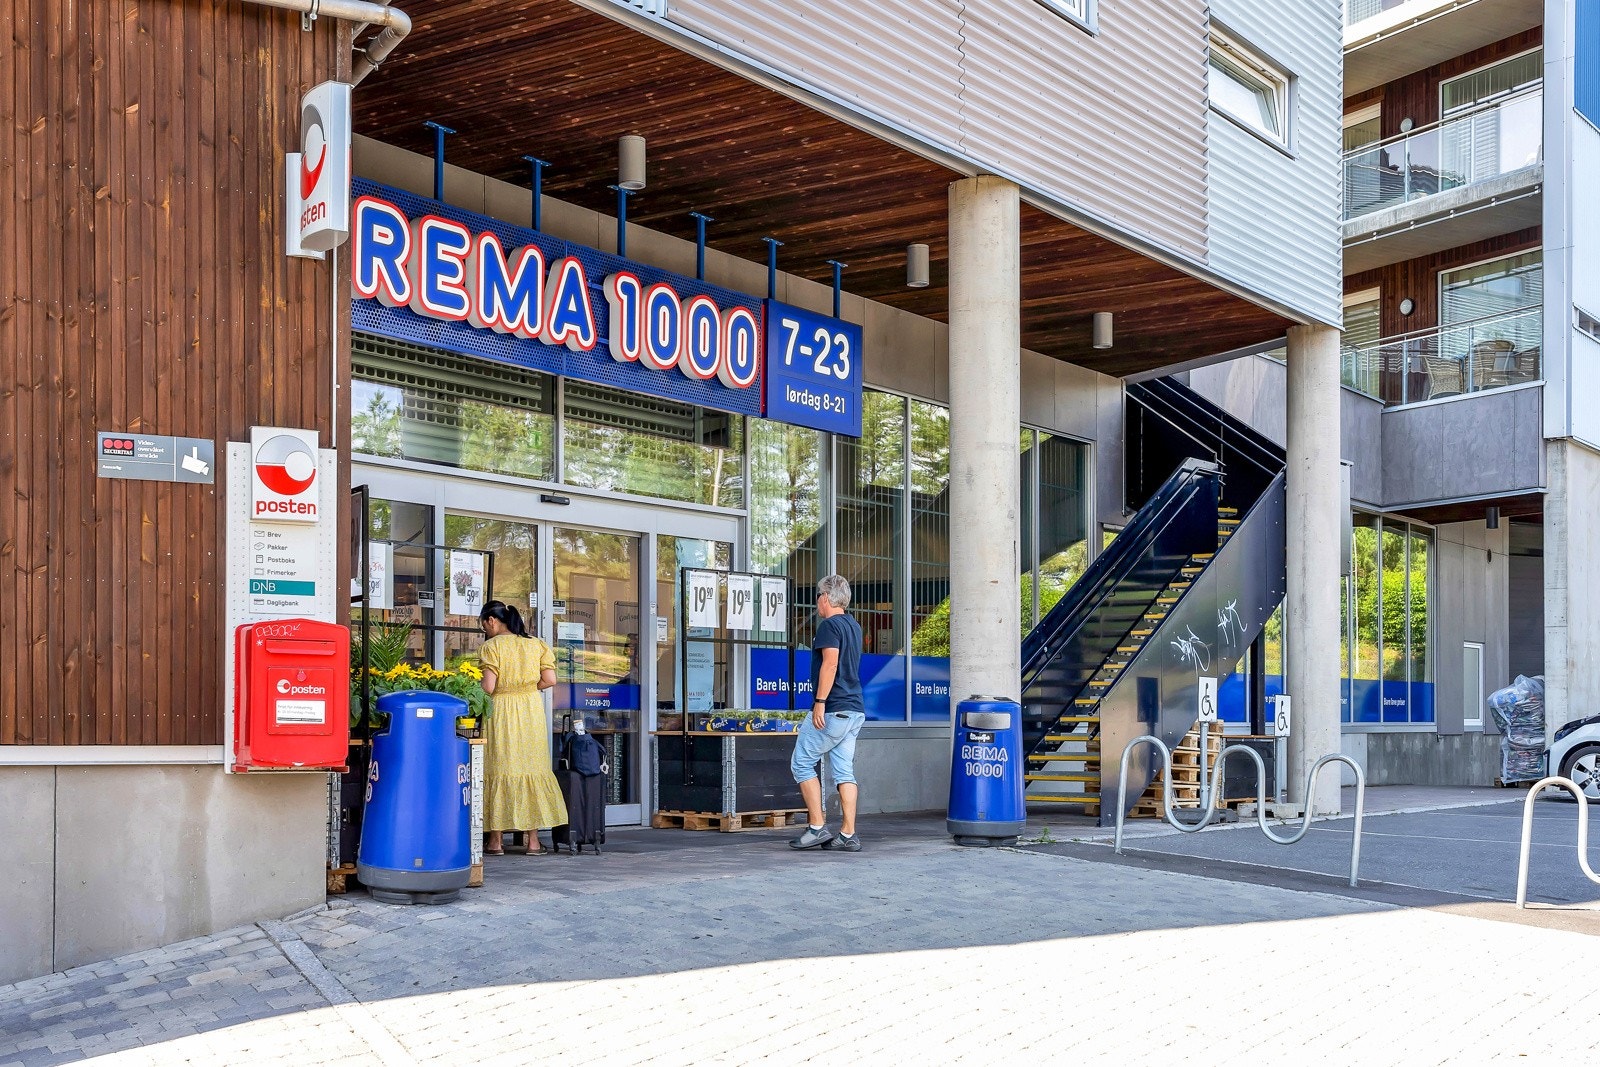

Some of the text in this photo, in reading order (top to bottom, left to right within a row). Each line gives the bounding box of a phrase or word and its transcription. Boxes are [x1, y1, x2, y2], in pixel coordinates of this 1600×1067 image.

[353, 195, 761, 389] REMA 1000
[781, 318, 851, 381] 7-23
[785, 383, 846, 415] lørdag 8-21
[255, 499, 317, 516] posten
[267, 556, 296, 564] Postboks
[252, 580, 276, 594] DNB
[266, 599, 299, 607] Dagligbank
[694, 586, 706, 612] 19
[732, 589, 744, 615] 19
[765, 592, 777, 617] 19
[291, 684, 326, 696] posten
[756, 677, 778, 691] Bare
[915, 682, 947, 695] Bare lave
[962, 745, 1008, 762] REMA
[965, 762, 1004, 778] 1000
